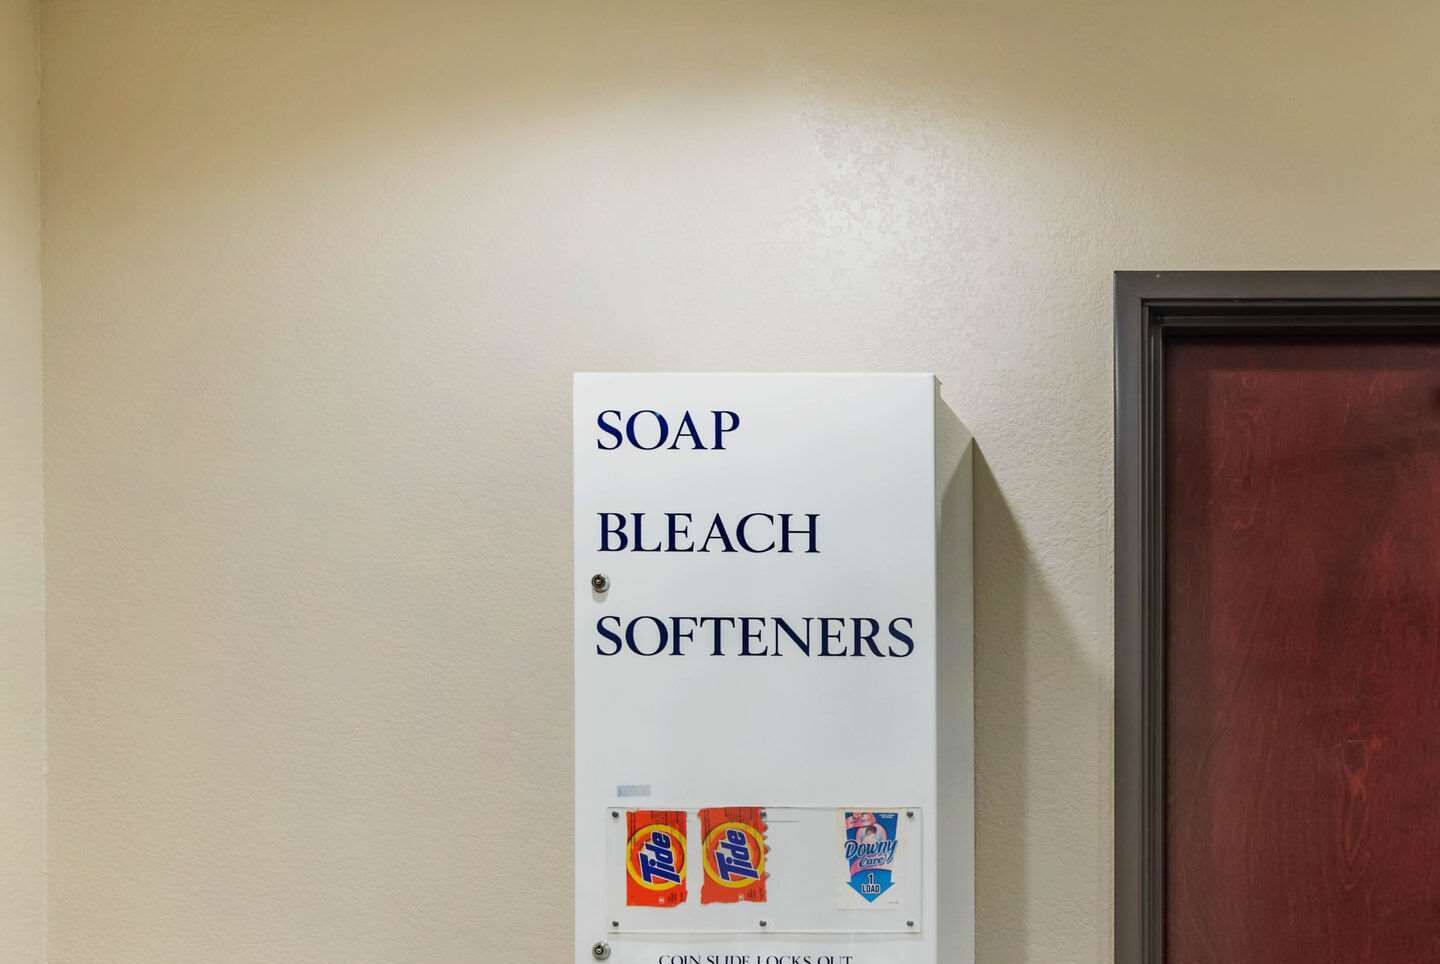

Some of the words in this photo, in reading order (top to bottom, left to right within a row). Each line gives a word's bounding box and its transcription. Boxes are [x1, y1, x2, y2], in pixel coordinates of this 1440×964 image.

[596, 409, 740, 451] SOAP
[596, 512, 821, 554] BLEACH
[595, 615, 915, 658] SOFTENERS
[638, 830, 682, 883] Tide
[714, 829, 760, 881] Tide
[845, 840, 898, 865] Downy
[862, 884, 881, 893] LOAD
[868, 873, 875, 884] 1
